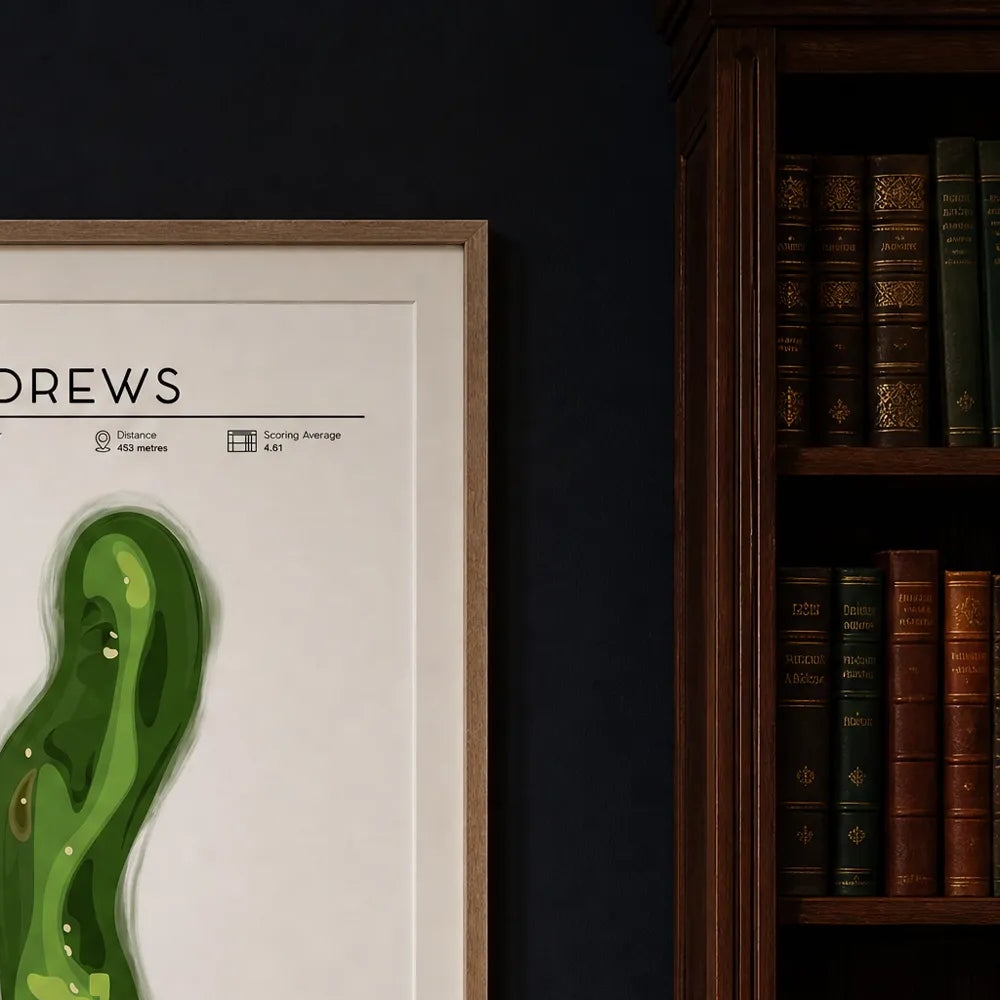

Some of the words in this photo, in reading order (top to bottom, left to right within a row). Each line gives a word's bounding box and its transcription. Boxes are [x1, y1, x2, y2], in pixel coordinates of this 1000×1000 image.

[116, 430, 157, 440] Distance
[263, 430, 300, 442] Scoring
[302, 430, 342, 442] Average
[116, 443, 135, 452] 453
[136, 444, 168, 452] metres
[263, 443, 283, 452] 4.61
